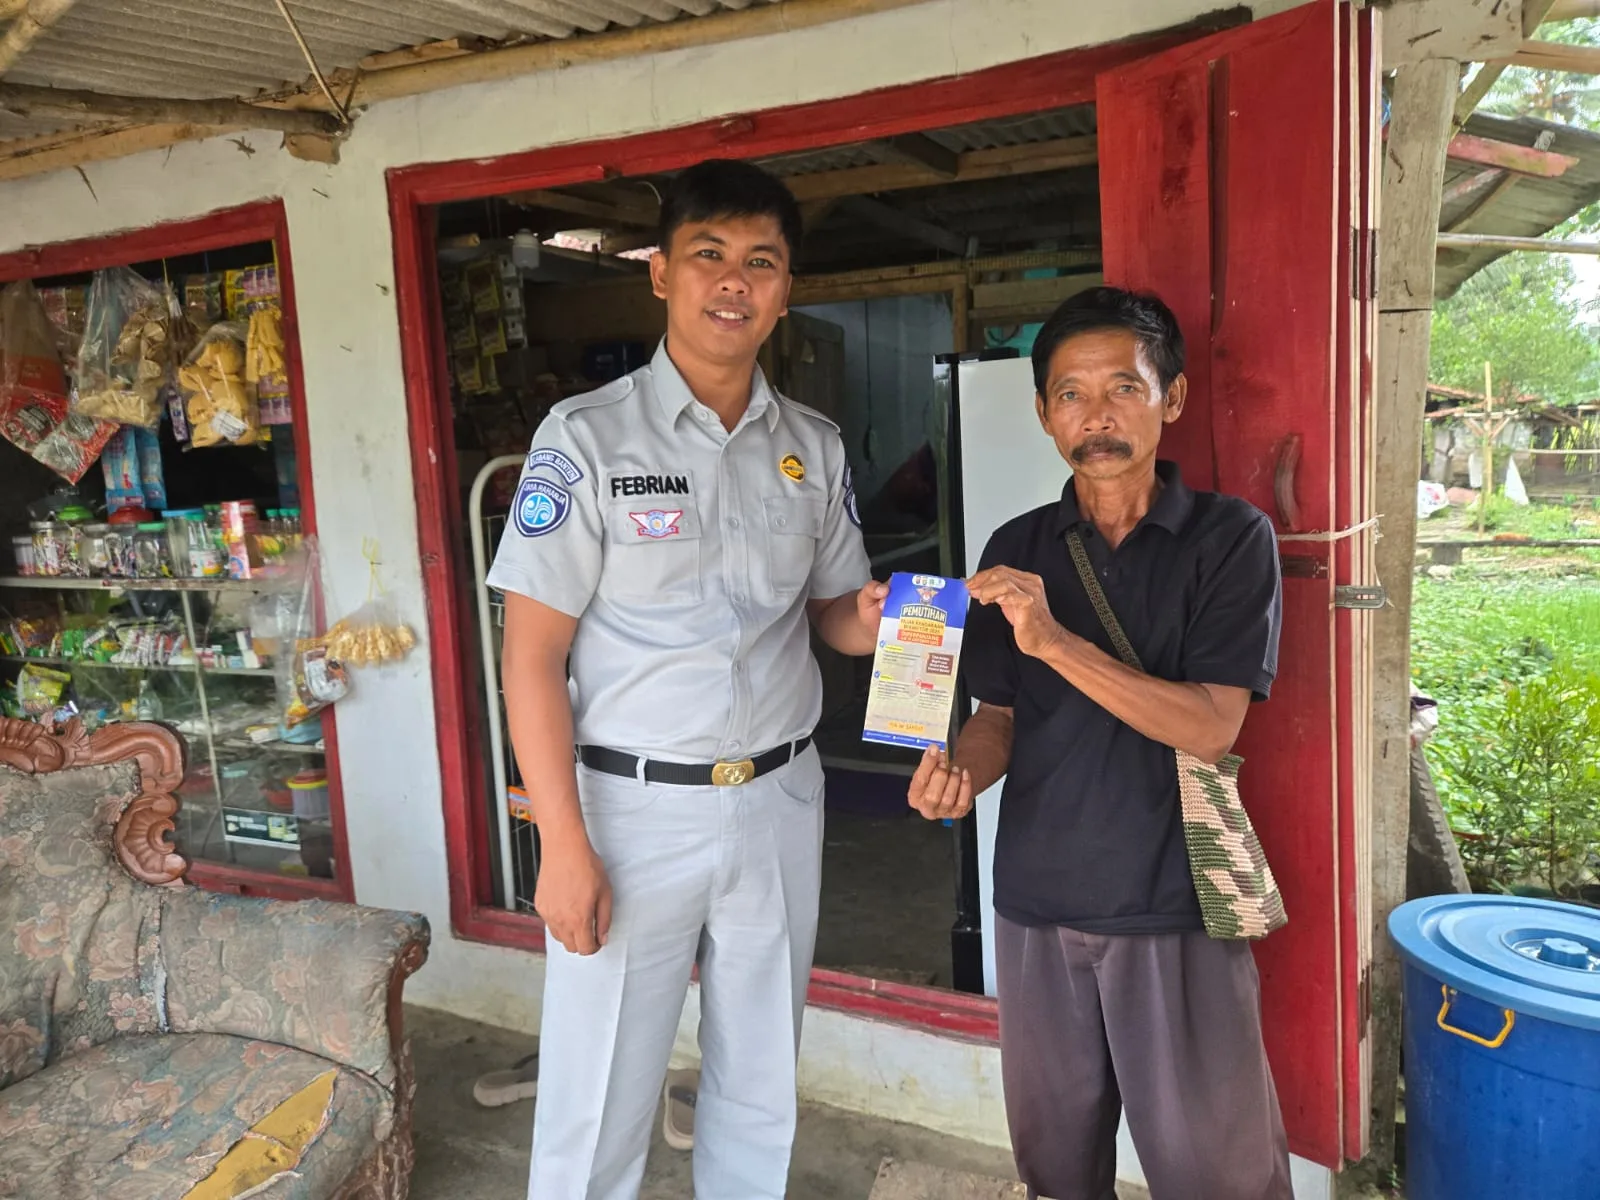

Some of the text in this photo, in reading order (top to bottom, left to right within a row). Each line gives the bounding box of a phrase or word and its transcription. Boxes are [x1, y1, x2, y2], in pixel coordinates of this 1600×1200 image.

[555, 457, 576, 480] BANTEN
[538, 484, 566, 505] RAHARJA
[611, 475, 689, 498] FEBRIAN
[903, 605, 946, 622] PEMUTIHAN
